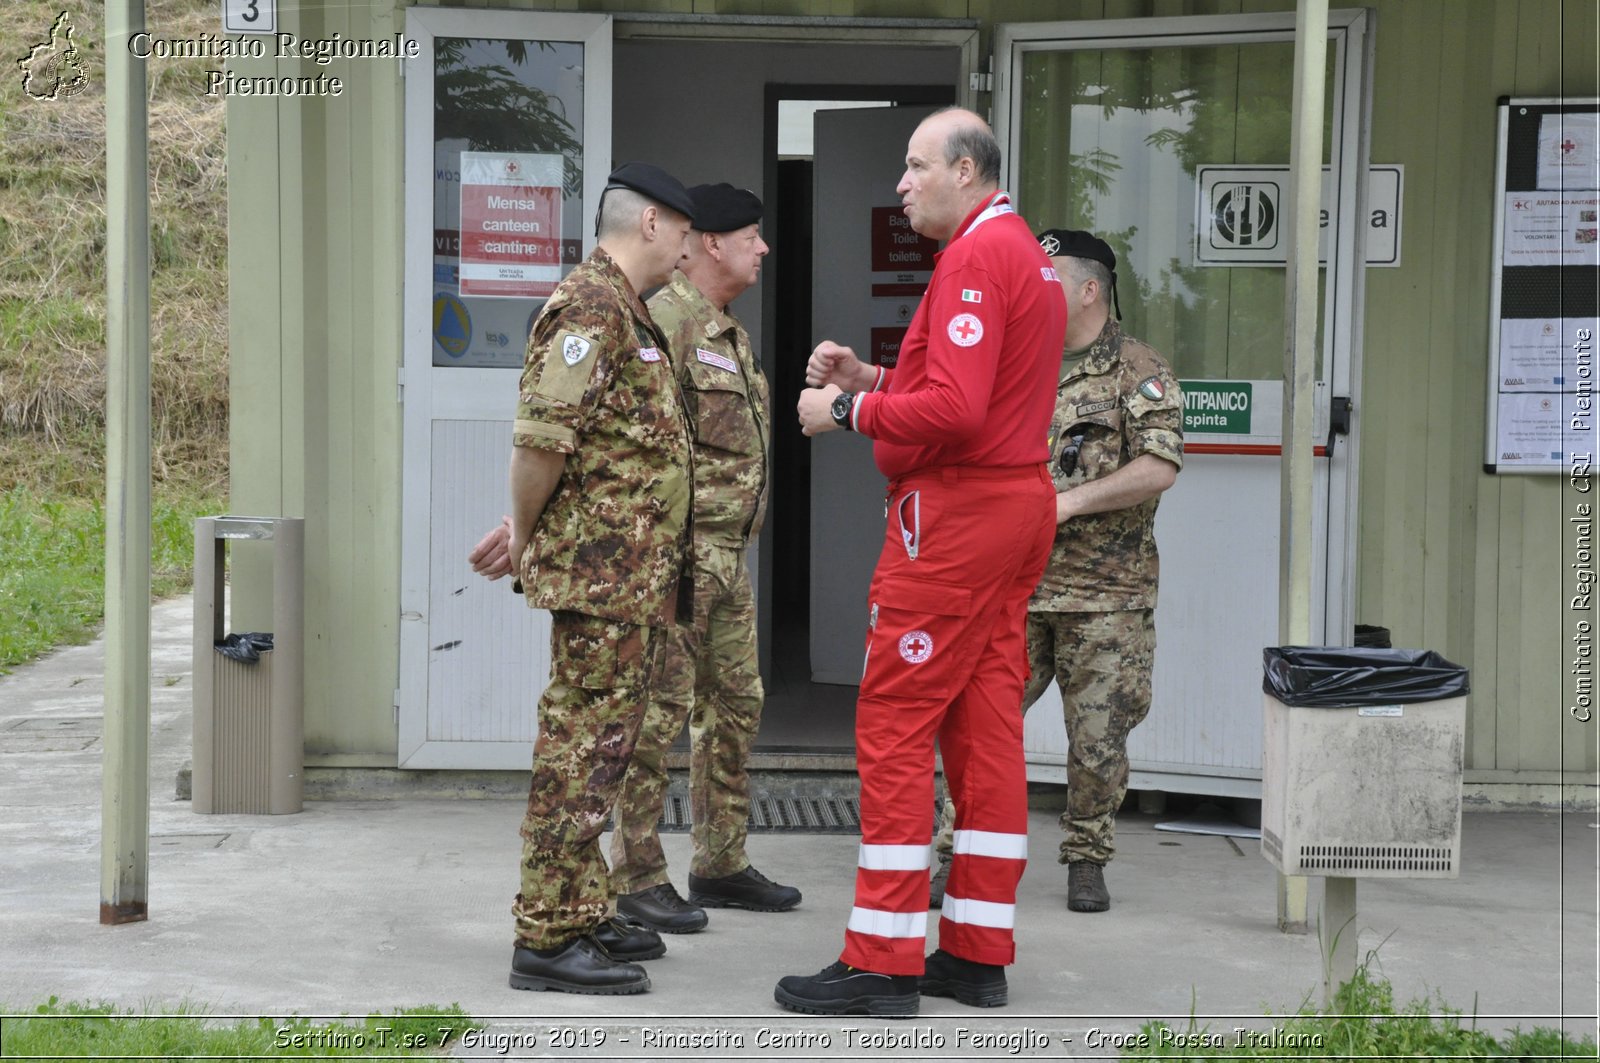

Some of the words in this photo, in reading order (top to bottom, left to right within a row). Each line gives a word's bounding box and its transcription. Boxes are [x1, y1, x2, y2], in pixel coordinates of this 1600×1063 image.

[241, 0, 259, 22] 3
[487, 195, 536, 210] Mensa
[482, 218, 540, 232] canteen
[889, 215, 912, 228] Bag
[892, 233, 918, 243] Toilet
[484, 240, 537, 254] cantine
[889, 251, 922, 261] toilette
[1182, 392, 1248, 411] NTIPANICO
[1185, 414, 1228, 428] spinta
